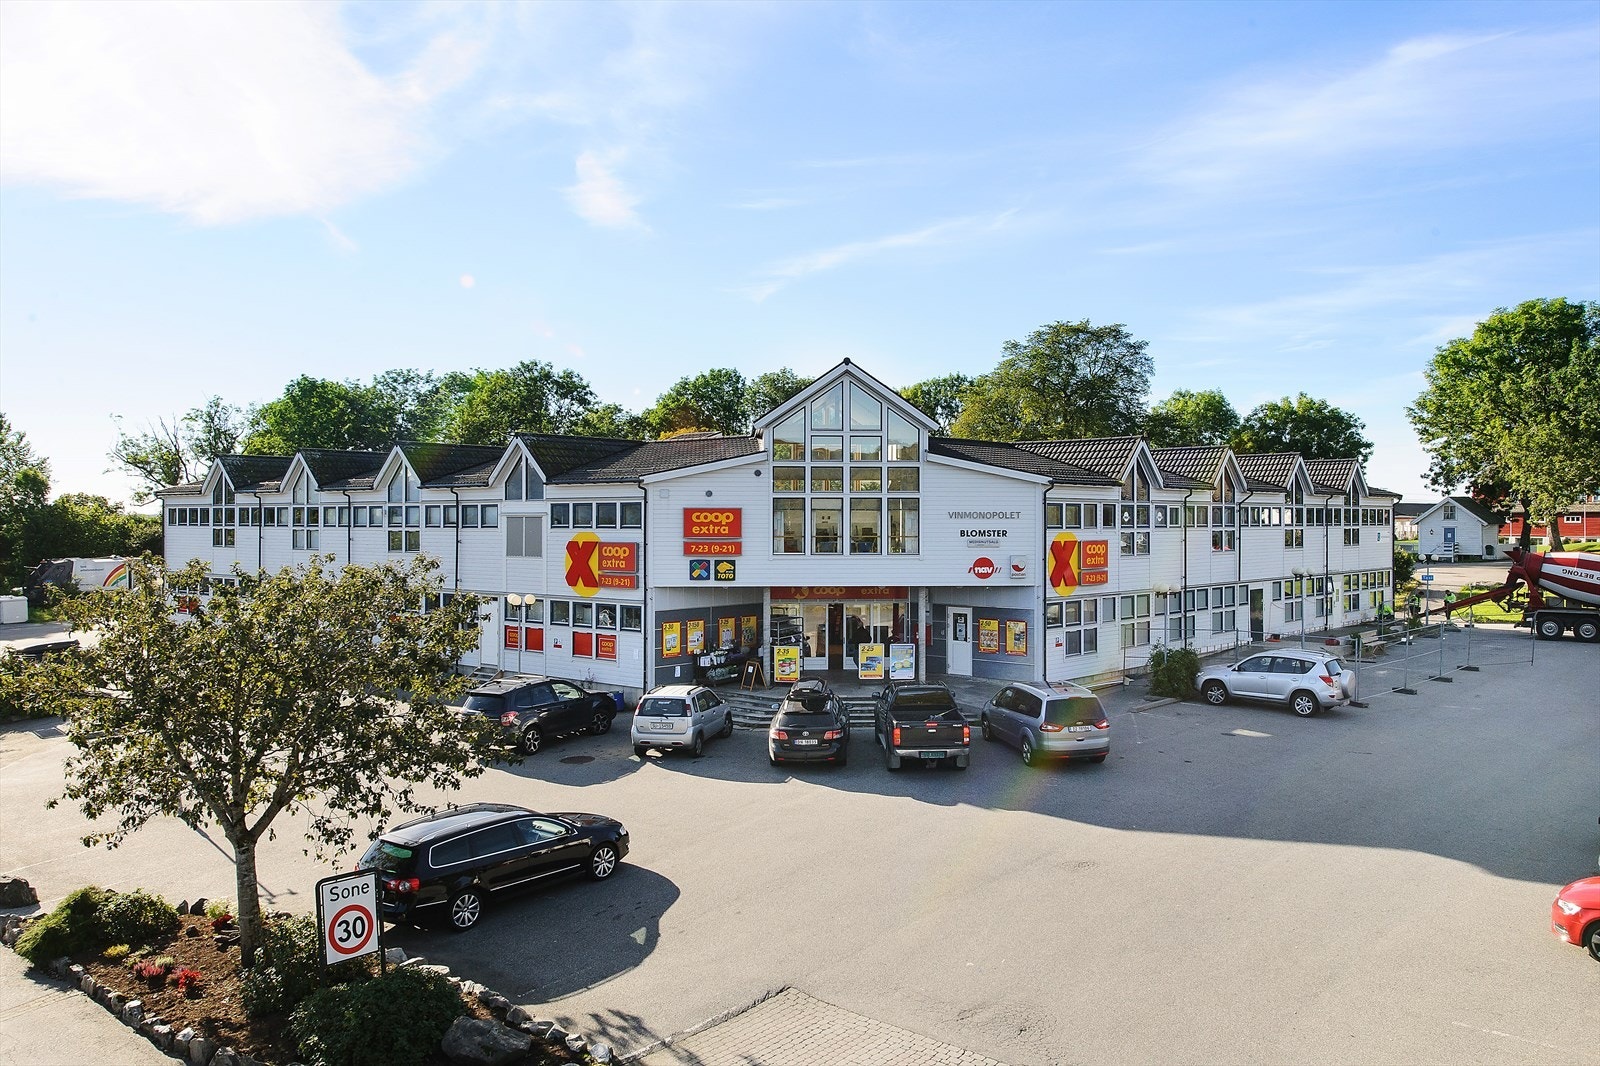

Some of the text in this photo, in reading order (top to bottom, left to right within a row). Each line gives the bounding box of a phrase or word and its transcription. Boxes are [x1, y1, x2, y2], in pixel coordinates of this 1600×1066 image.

[692, 512, 734, 525] coop
[948, 511, 1021, 519] VINMONOPOLET
[692, 525, 729, 534] extra
[960, 529, 1008, 537] BLOMSTER
[602, 547, 630, 559] coop
[691, 544, 735, 554] 7-23 (9-21)
[1086, 544, 1106, 556] coop
[565, 541, 599, 587] X
[602, 558, 626, 568] extra
[1050, 541, 1078, 587] X
[1086, 556, 1104, 565] extra
[1562, 568, 1594, 580] BETONG
[613, 578, 631, 587] (9-21)
[813, 587, 846, 596] coop
[861, 587, 890, 595] extra
[329, 882, 370, 902] Sone
[337, 915, 366, 943] 30
